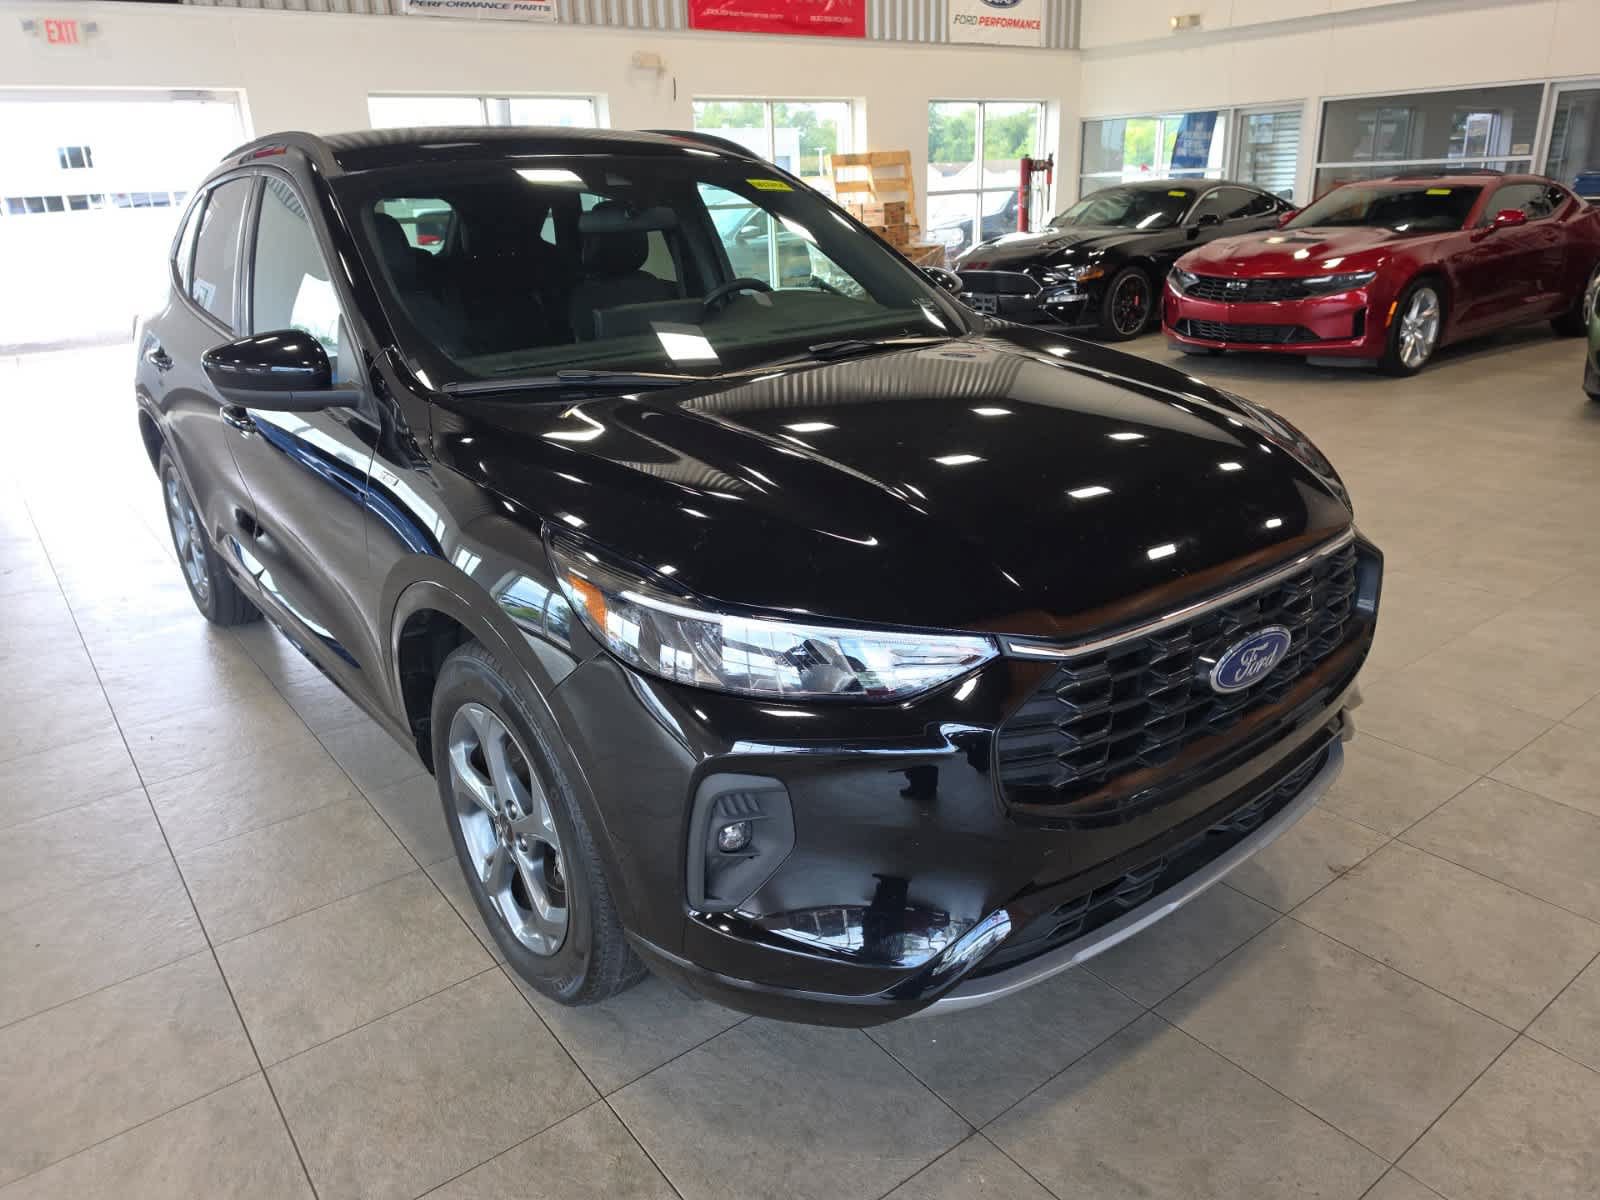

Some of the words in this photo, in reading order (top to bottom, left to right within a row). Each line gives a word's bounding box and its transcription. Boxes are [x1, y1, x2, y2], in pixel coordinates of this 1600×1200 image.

[409, 0, 510, 9] PERFORMANCE
[953, 14, 978, 25] FORD
[978, 16, 1041, 30] PERFORMANCE
[44, 20, 79, 45] EXIT
[1234, 642, 1279, 682] Ford
